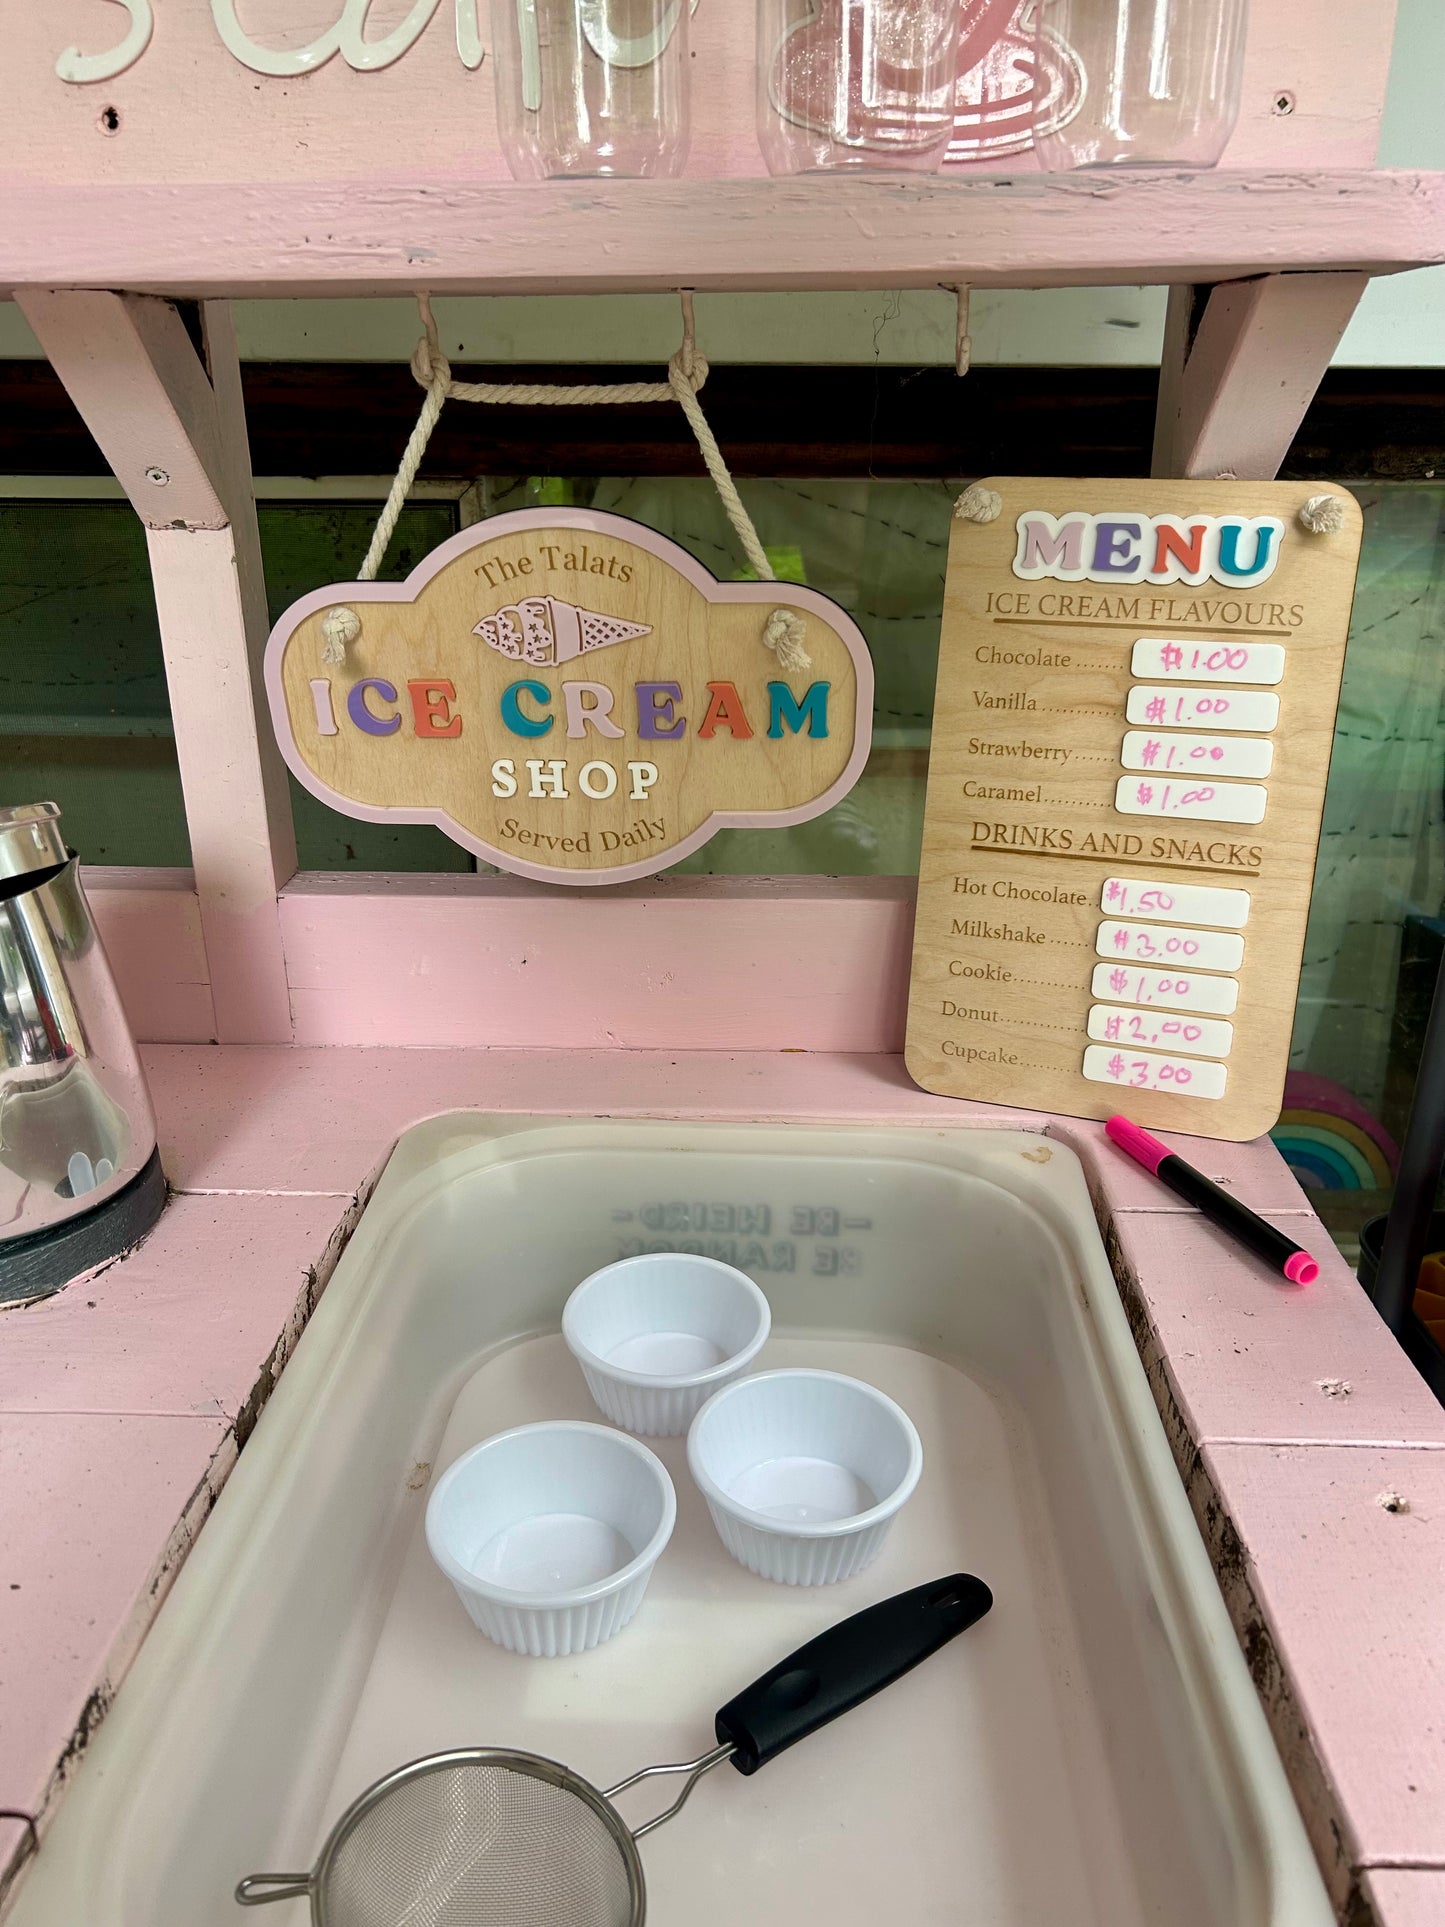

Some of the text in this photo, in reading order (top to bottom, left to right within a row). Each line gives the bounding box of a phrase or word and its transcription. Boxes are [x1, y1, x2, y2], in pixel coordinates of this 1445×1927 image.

[1021, 520, 1275, 576] MENU
[474, 545, 634, 590] The Talats
[986, 592, 1304, 627] ICE CREAM FLAVOURS
[975, 645, 1072, 669] Chocolate
[1160, 642, 1249, 673] $1.00
[309, 678, 831, 740] ICE CREAM
[973, 690, 1038, 712] Vanilla
[1145, 696, 1230, 724] $1.00
[967, 738, 1073, 766] Strawberry
[1140, 738, 1225, 769] $1.00
[491, 758, 660, 801] SHOP
[962, 780, 1042, 803] Caramel
[1136, 783, 1216, 811] $1.00
[499, 817, 668, 855] Served Daily
[971, 821, 1263, 867] DRINKS AND SNACKS
[952, 877, 1087, 907] Hot Chocolate
[1105, 880, 1174, 914] $1.50
[950, 918, 1047, 945] Milkshake
[1113, 928, 1200, 959] $3.00
[948, 960, 1013, 983] Cookie
[1109, 967, 1190, 1002] $1.00
[941, 1000, 999, 1024] Donut
[1104, 1014, 1202, 1043] $2.00
[941, 1040, 1019, 1067] Cupcake
[1107, 1053, 1193, 1089] $3.00
